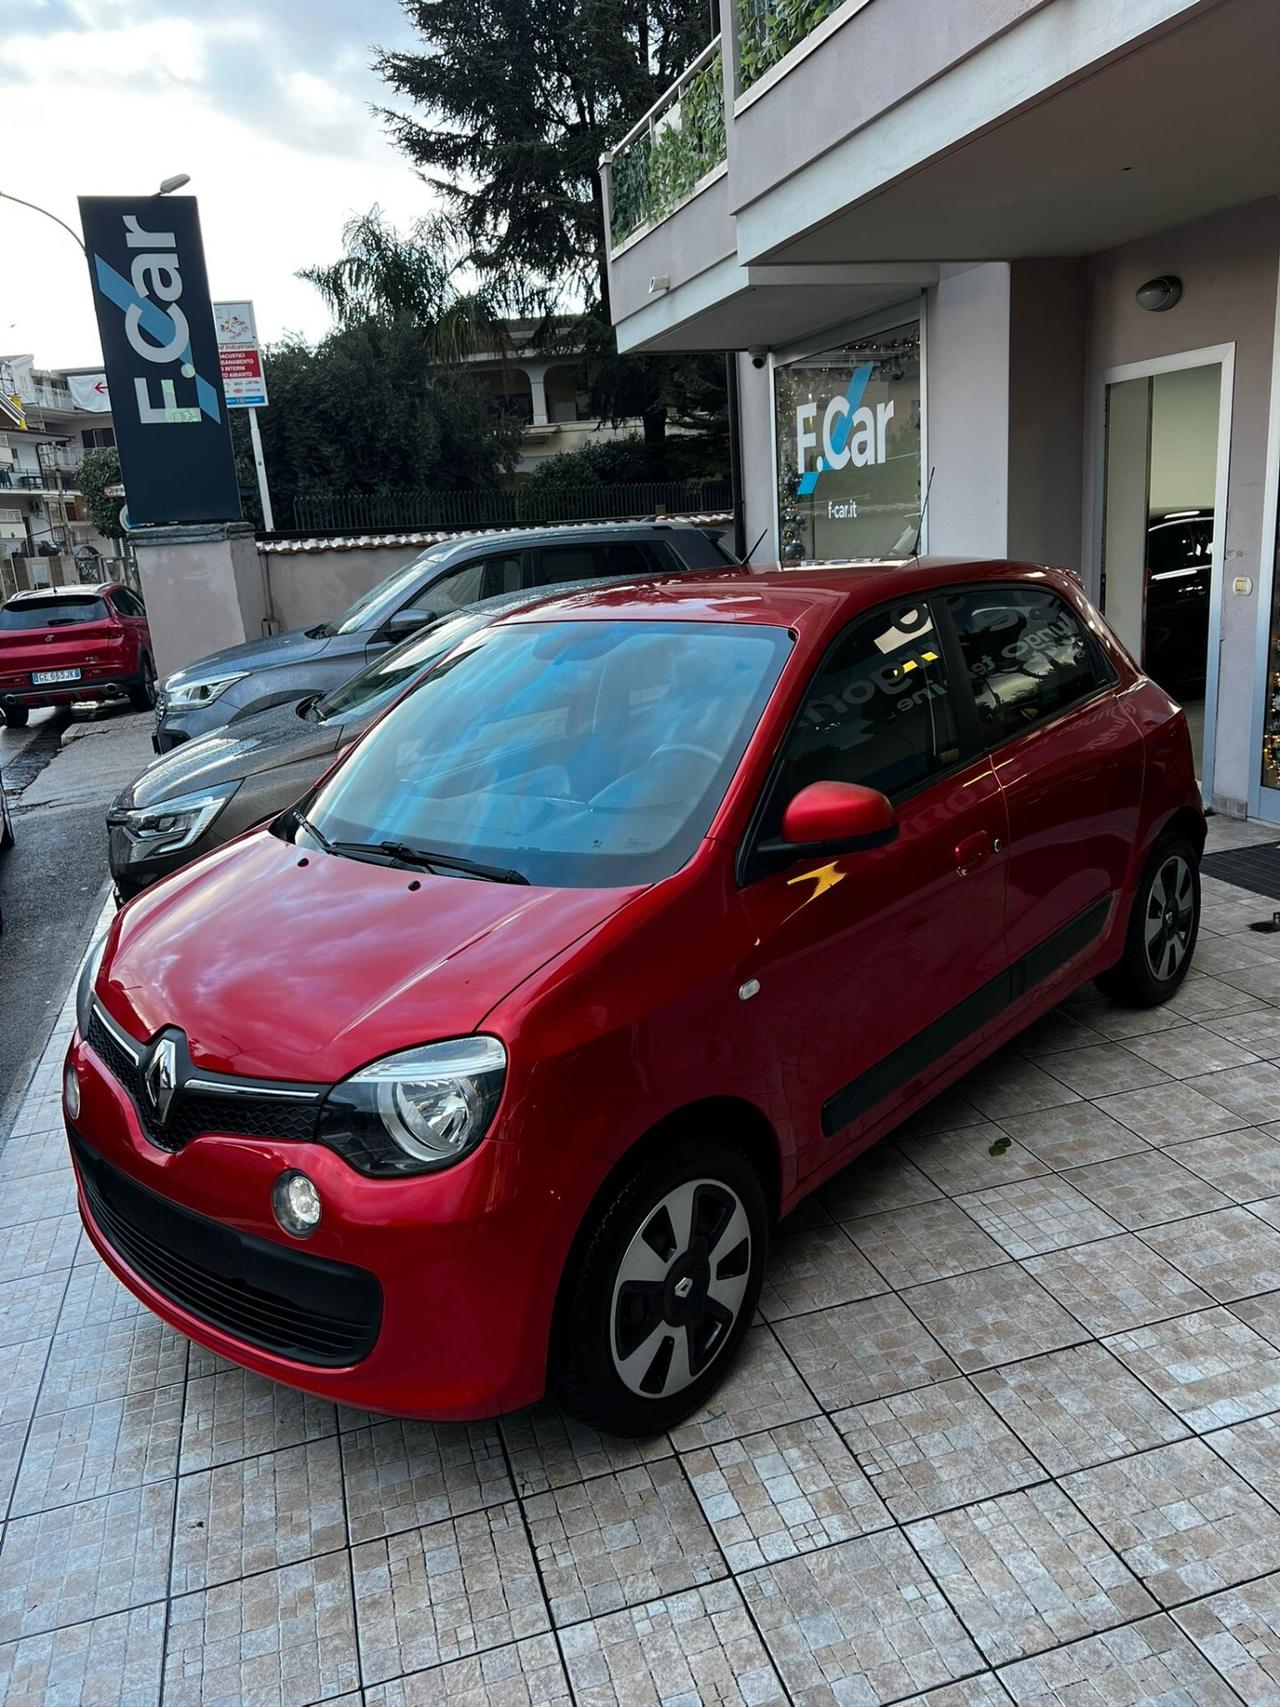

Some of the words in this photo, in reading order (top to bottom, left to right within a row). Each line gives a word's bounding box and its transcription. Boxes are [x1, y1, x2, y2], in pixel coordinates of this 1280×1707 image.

[122, 215, 202, 424] F.Car
[796, 396, 894, 474] F.Car
[828, 500, 857, 519] f-car.it
